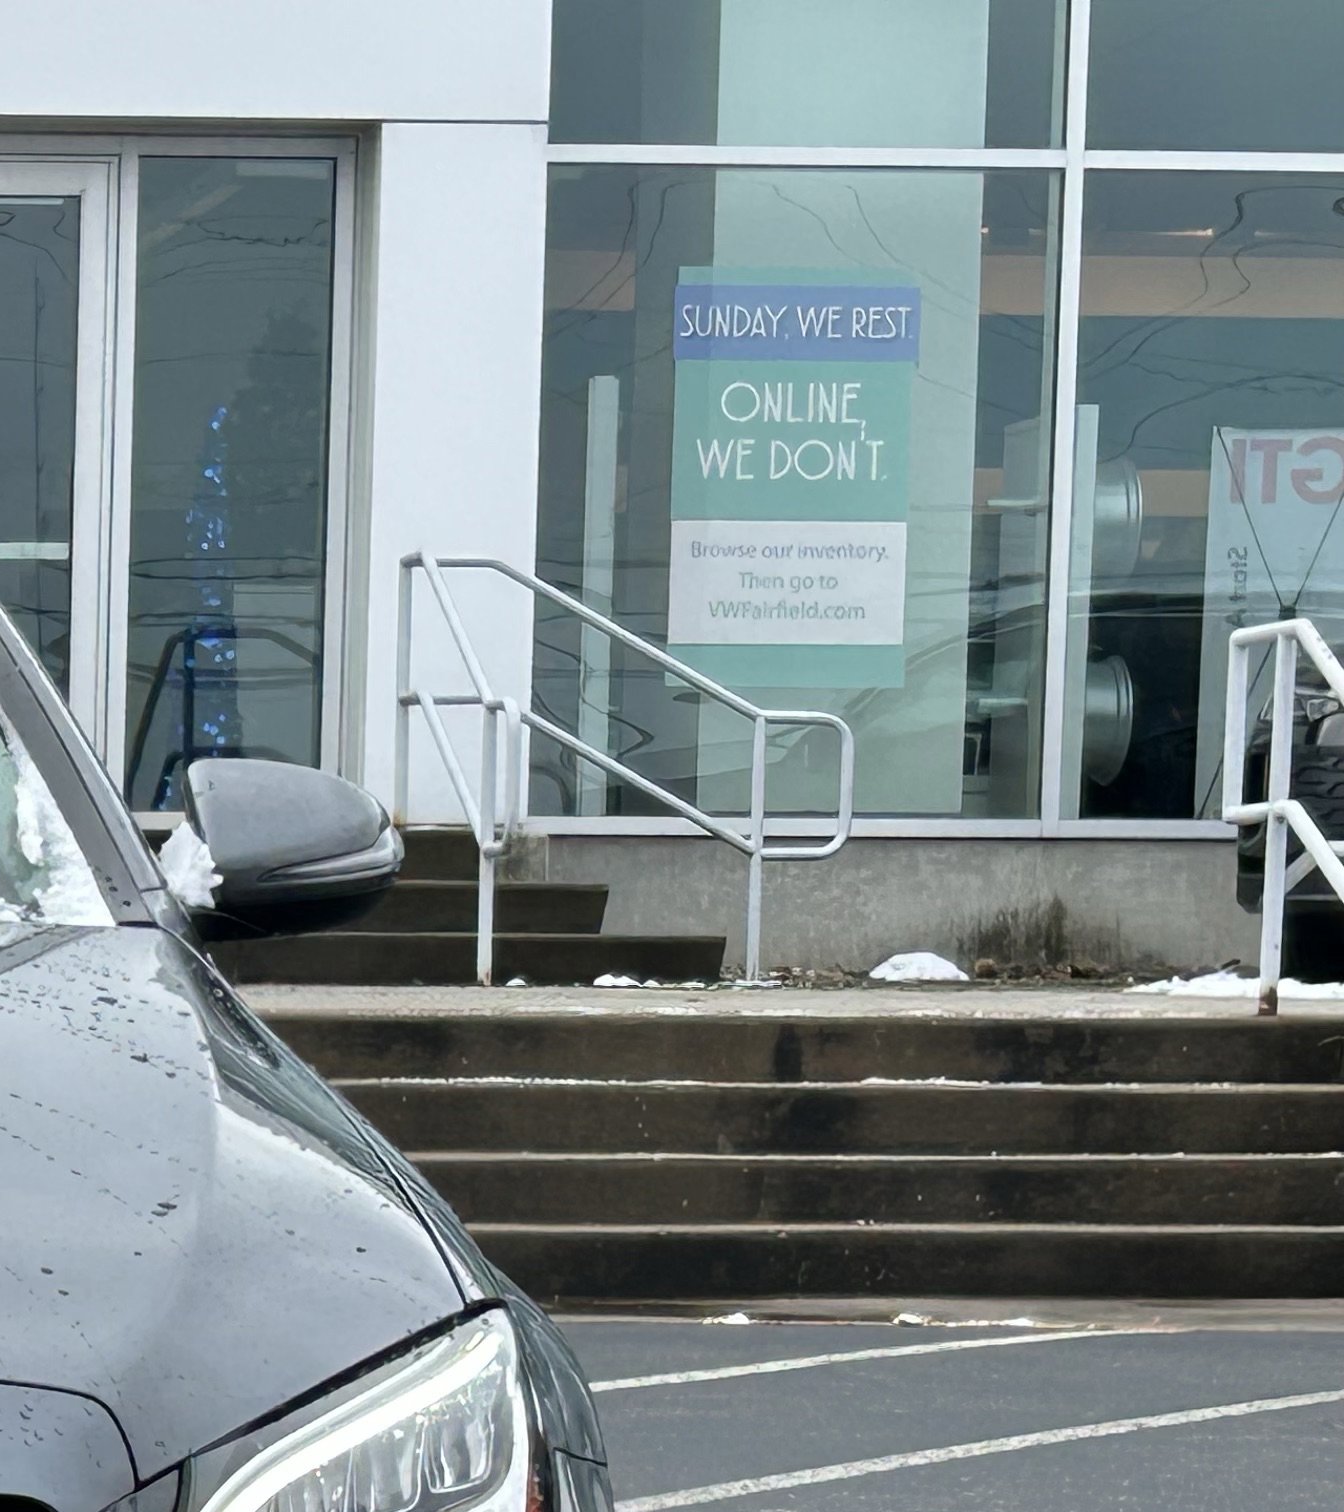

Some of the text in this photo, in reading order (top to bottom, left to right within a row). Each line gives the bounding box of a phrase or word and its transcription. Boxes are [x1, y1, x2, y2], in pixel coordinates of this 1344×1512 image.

[679, 304, 913, 340] SUNDAY, WE REST.
[720, 381, 867, 430] ONLINE,
[696, 437, 756, 481] WE
[690, 540, 758, 559] Browse
[761, 544, 791, 559] our
[738, 571, 839, 593] Then go to
[707, 600, 867, 621] VWFairfield.com
